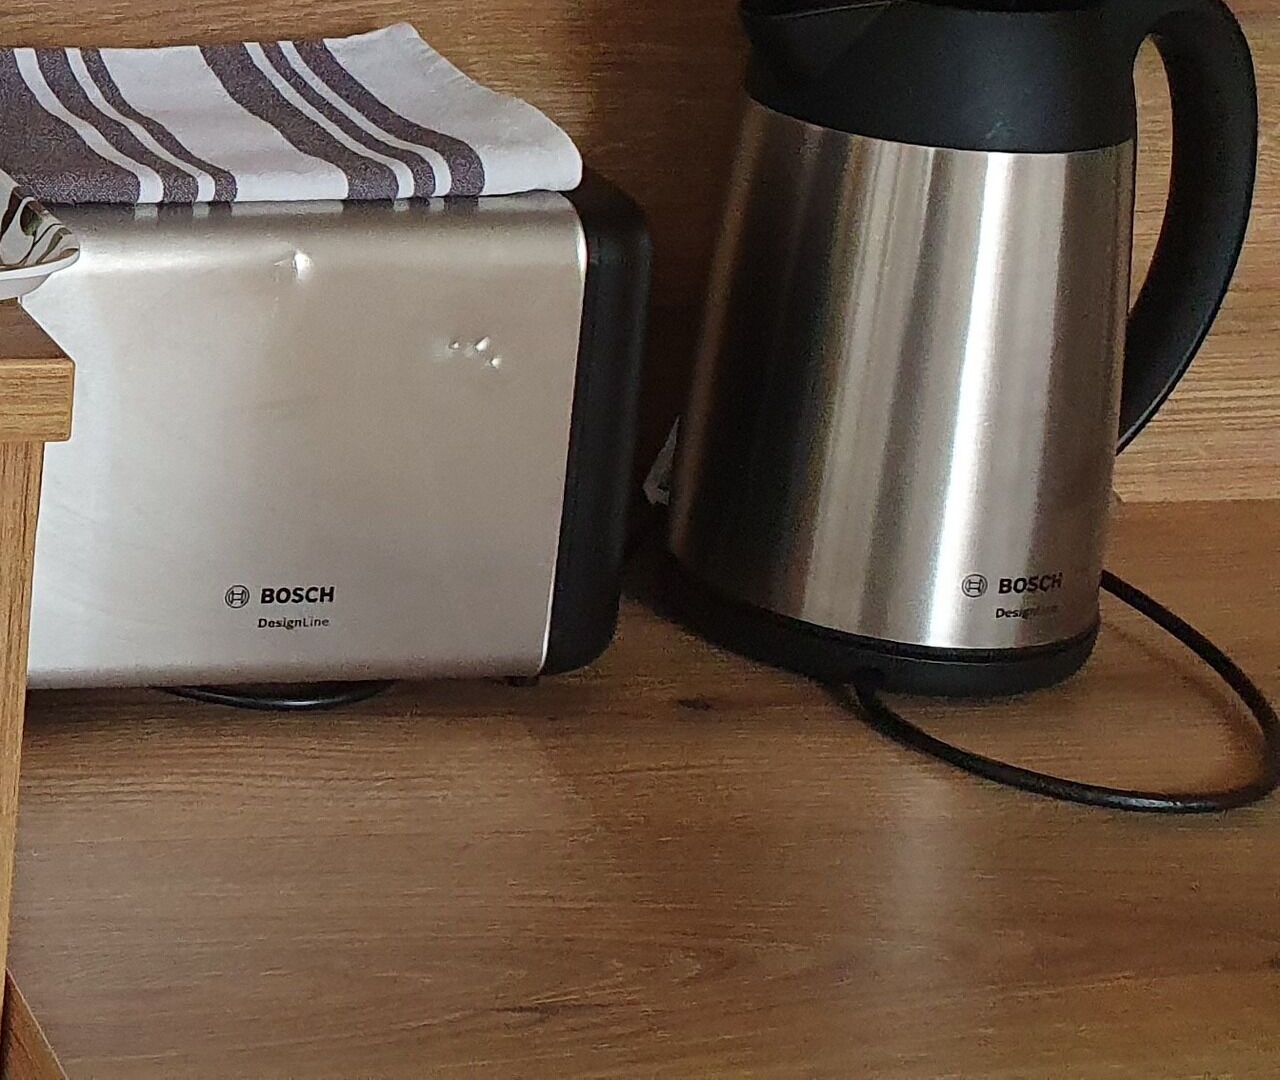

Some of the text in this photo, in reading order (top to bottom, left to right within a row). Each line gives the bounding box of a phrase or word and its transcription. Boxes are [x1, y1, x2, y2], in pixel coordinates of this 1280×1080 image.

[998, 572, 1063, 594] BOSCH
[260, 585, 335, 604] BOSCH
[257, 616, 330, 630] DesignLine
